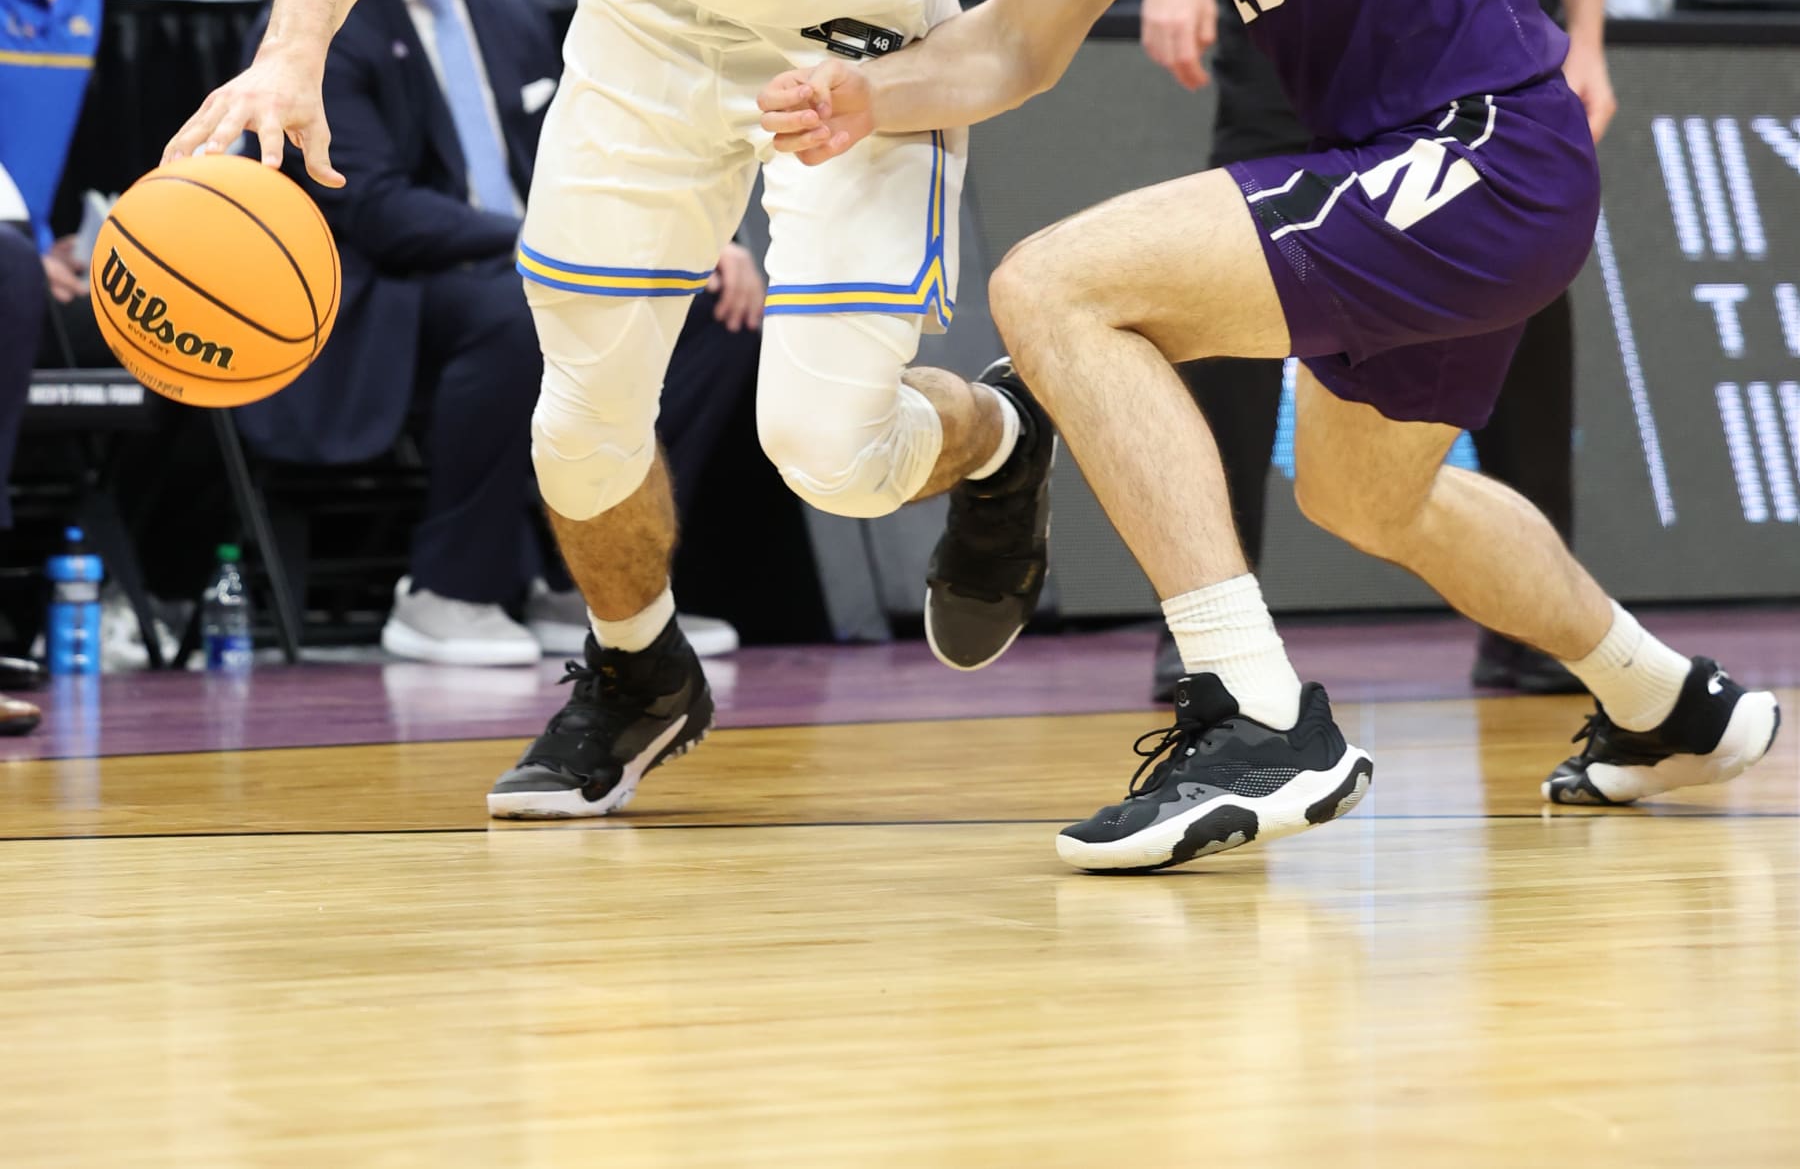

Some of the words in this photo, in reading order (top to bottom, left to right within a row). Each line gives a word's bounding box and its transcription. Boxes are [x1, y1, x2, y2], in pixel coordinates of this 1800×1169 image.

[873, 36, 889, 51] 48
[1358, 138, 1480, 231] N
[101, 246, 234, 370] Wilson
